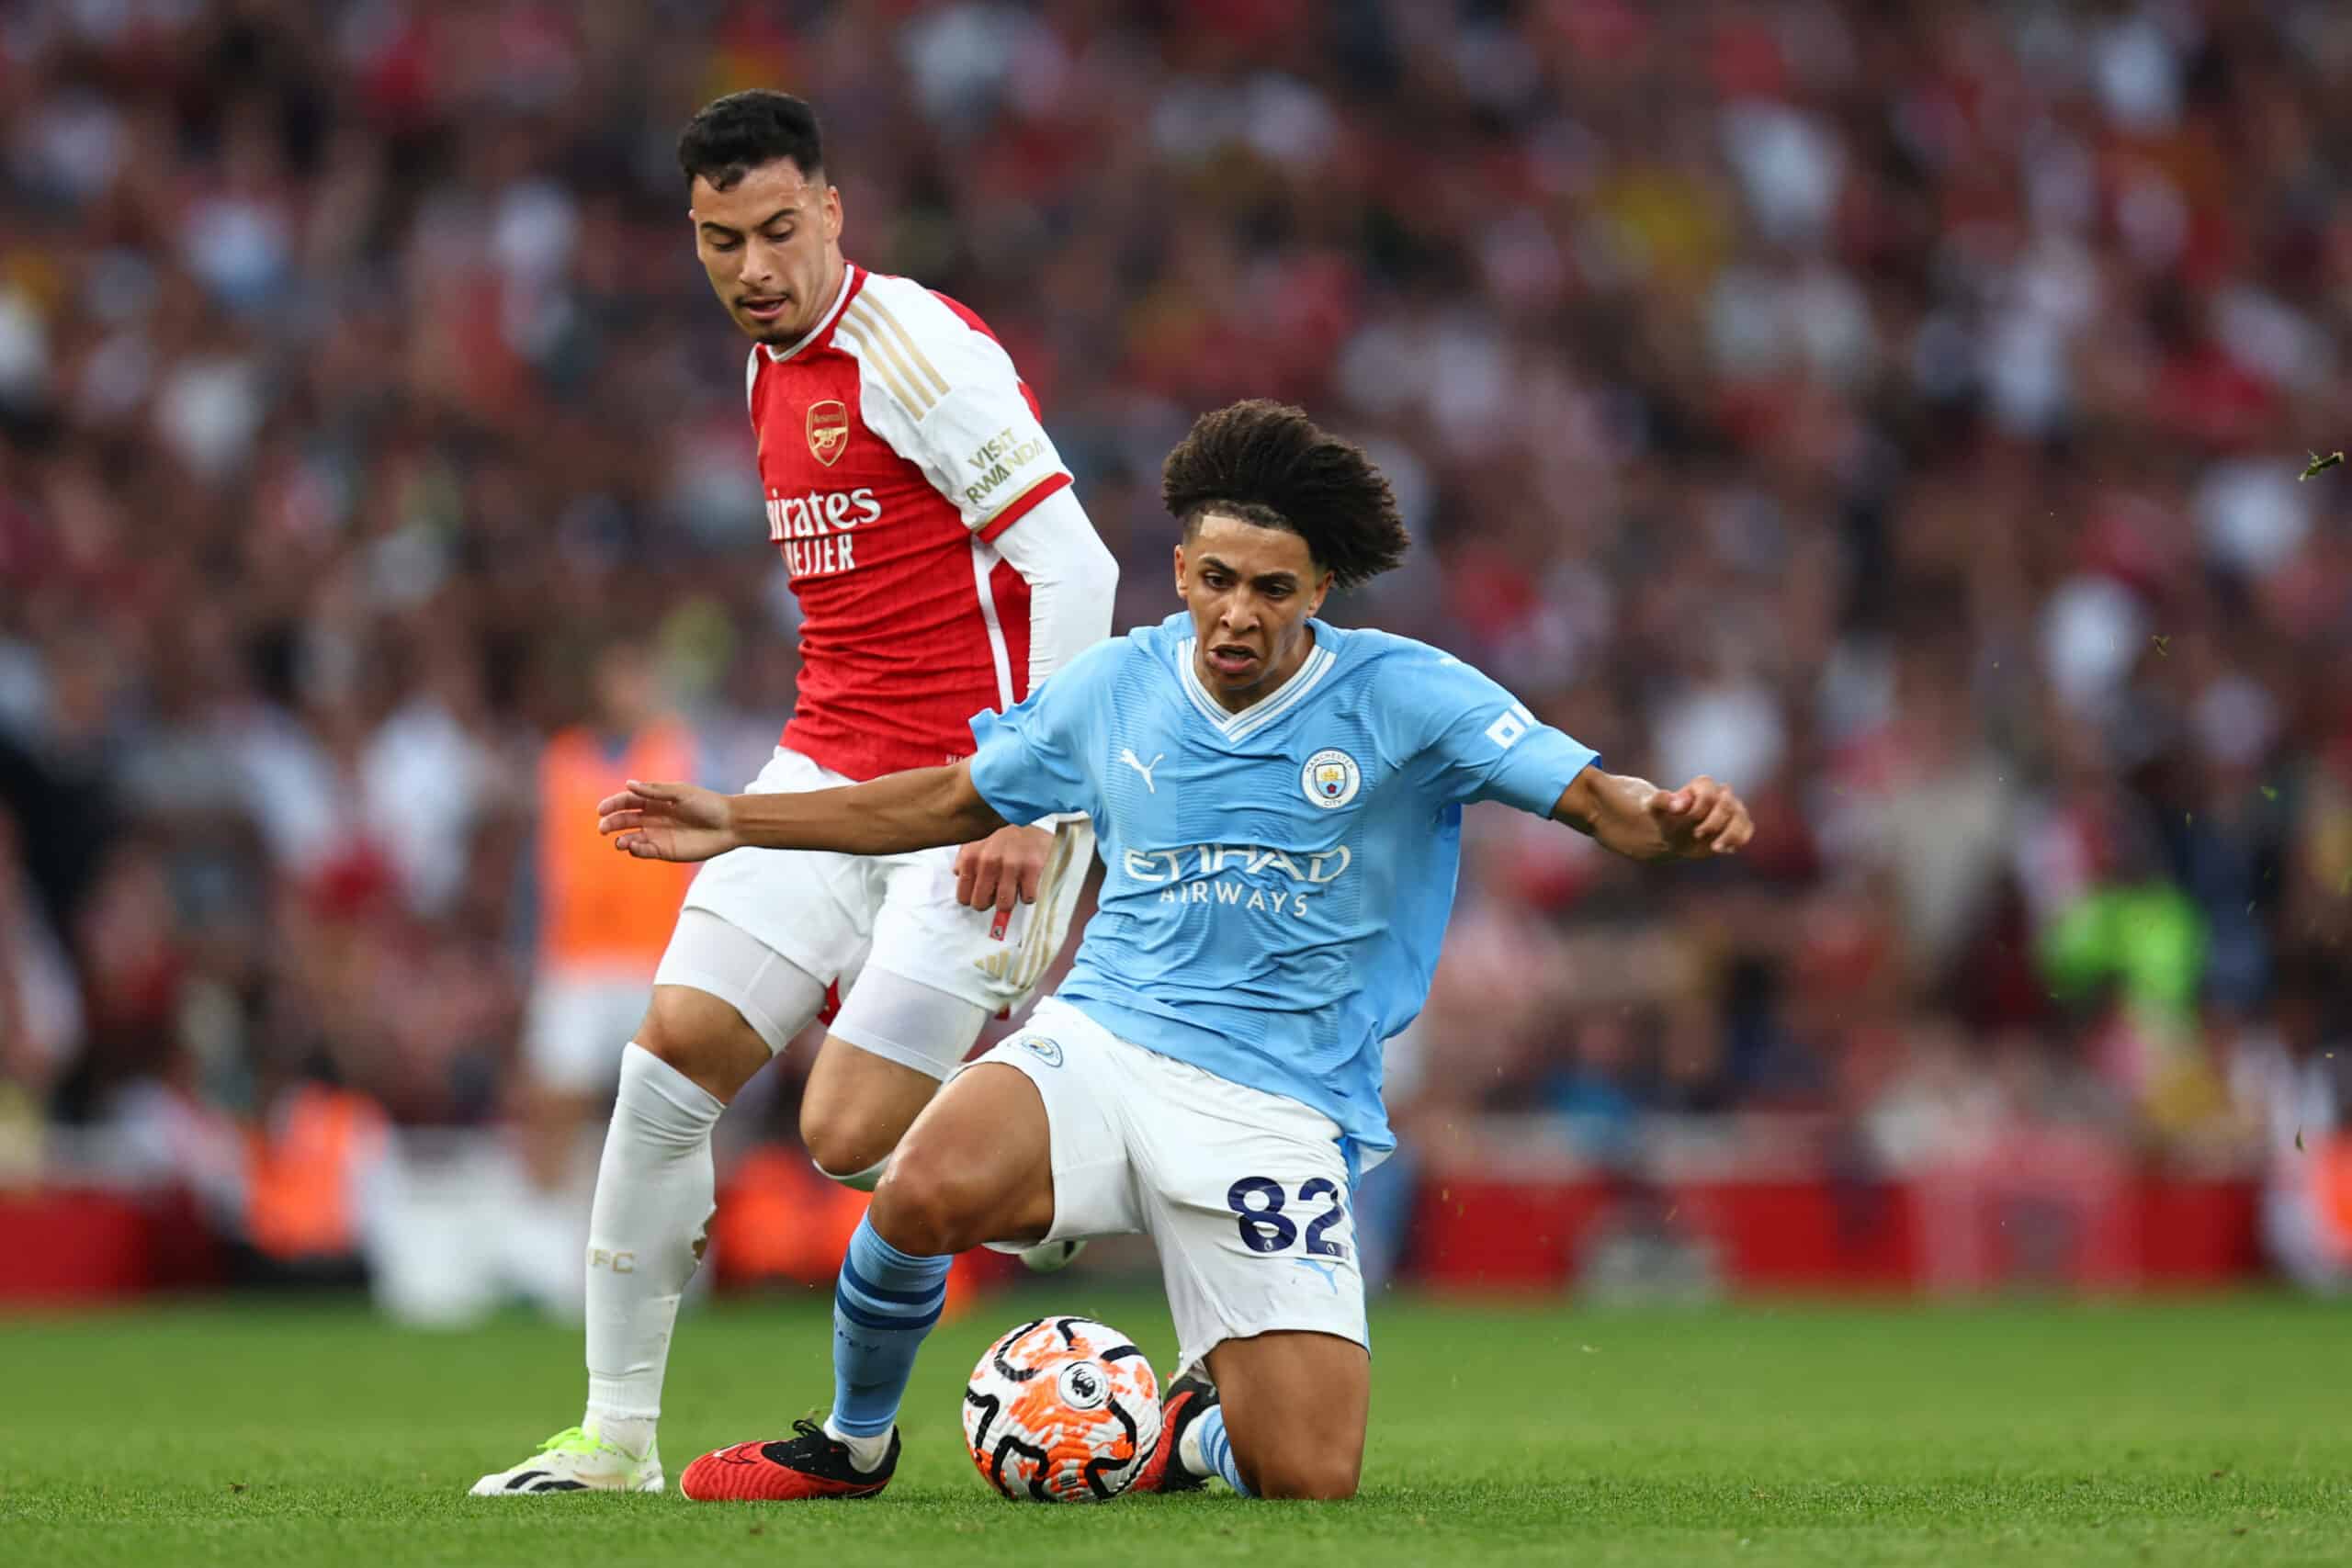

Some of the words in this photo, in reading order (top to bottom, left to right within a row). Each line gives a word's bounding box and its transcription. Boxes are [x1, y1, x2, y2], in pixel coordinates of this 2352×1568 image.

[968, 427, 1014, 468] VISIT
[966, 438, 1045, 504] RWANDA
[1124, 845, 1351, 882] ETIHAD
[1159, 881, 1308, 917] AIRWAYS
[1227, 1177, 1349, 1259] 82
[588, 1249, 633, 1274] FC
